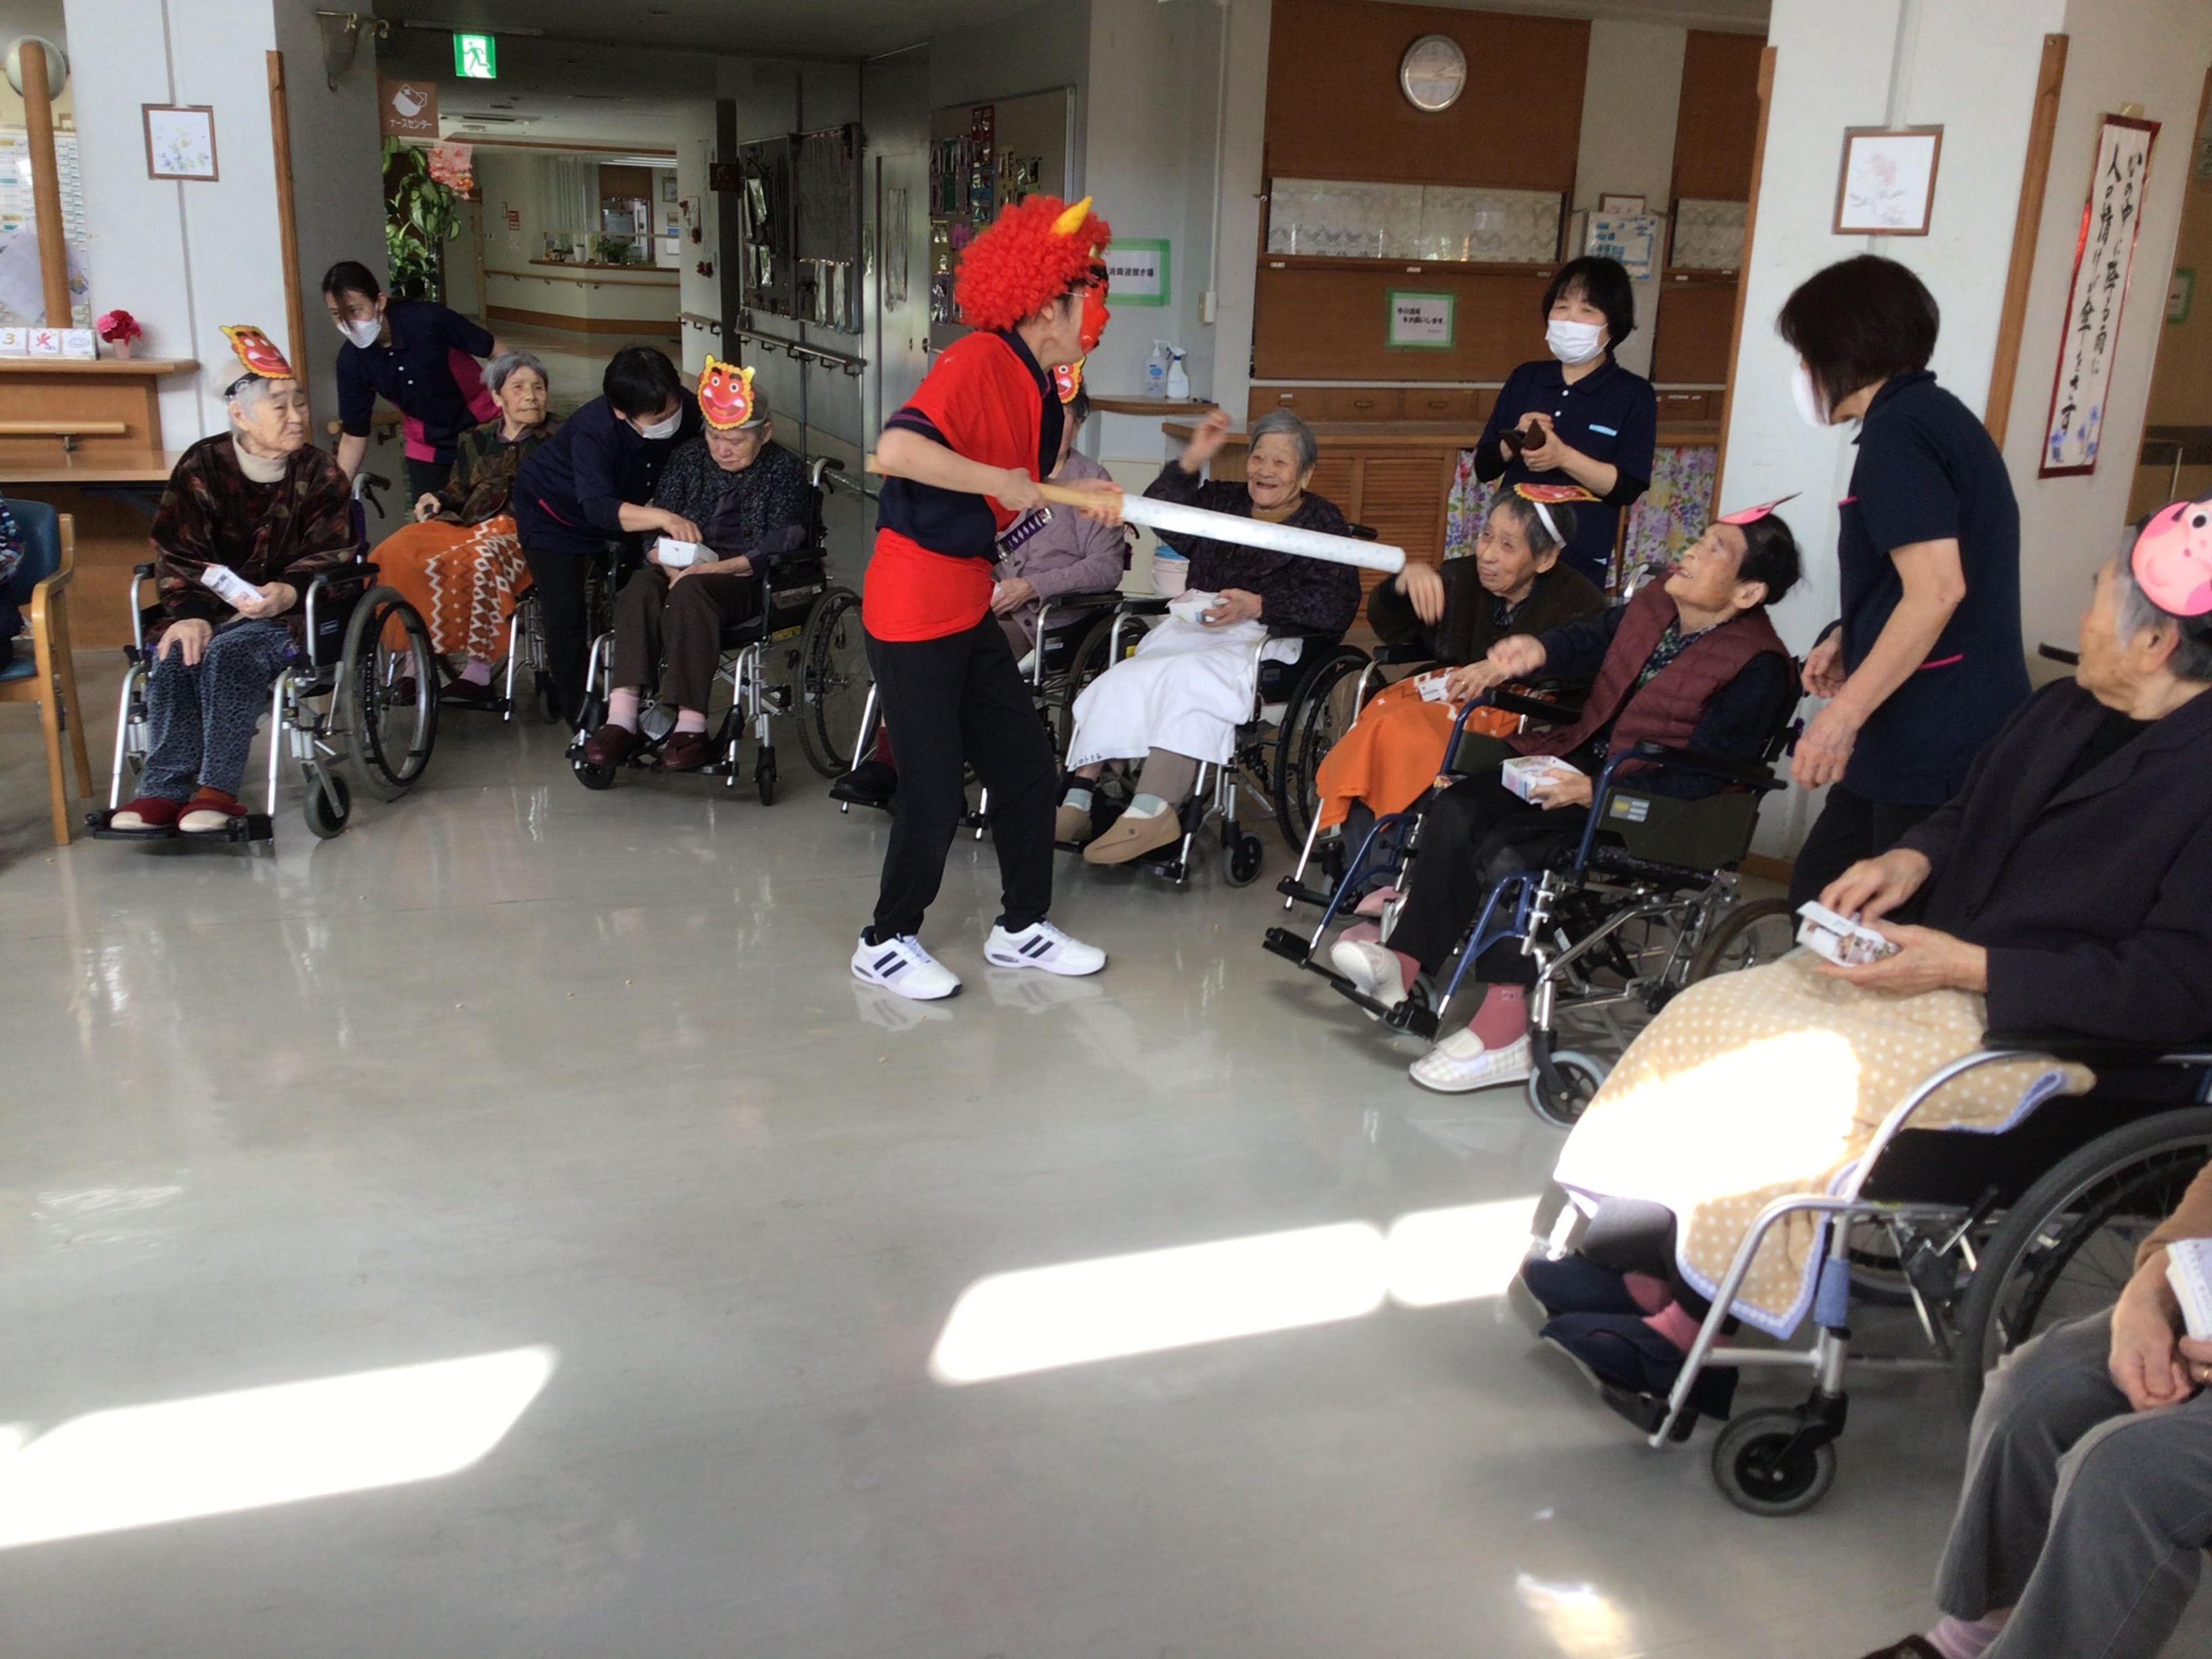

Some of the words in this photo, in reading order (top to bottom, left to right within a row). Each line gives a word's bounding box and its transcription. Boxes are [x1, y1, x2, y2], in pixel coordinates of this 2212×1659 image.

[390, 118, 433, 129] ナースセンター
[2, 333, 15, 345] 3
